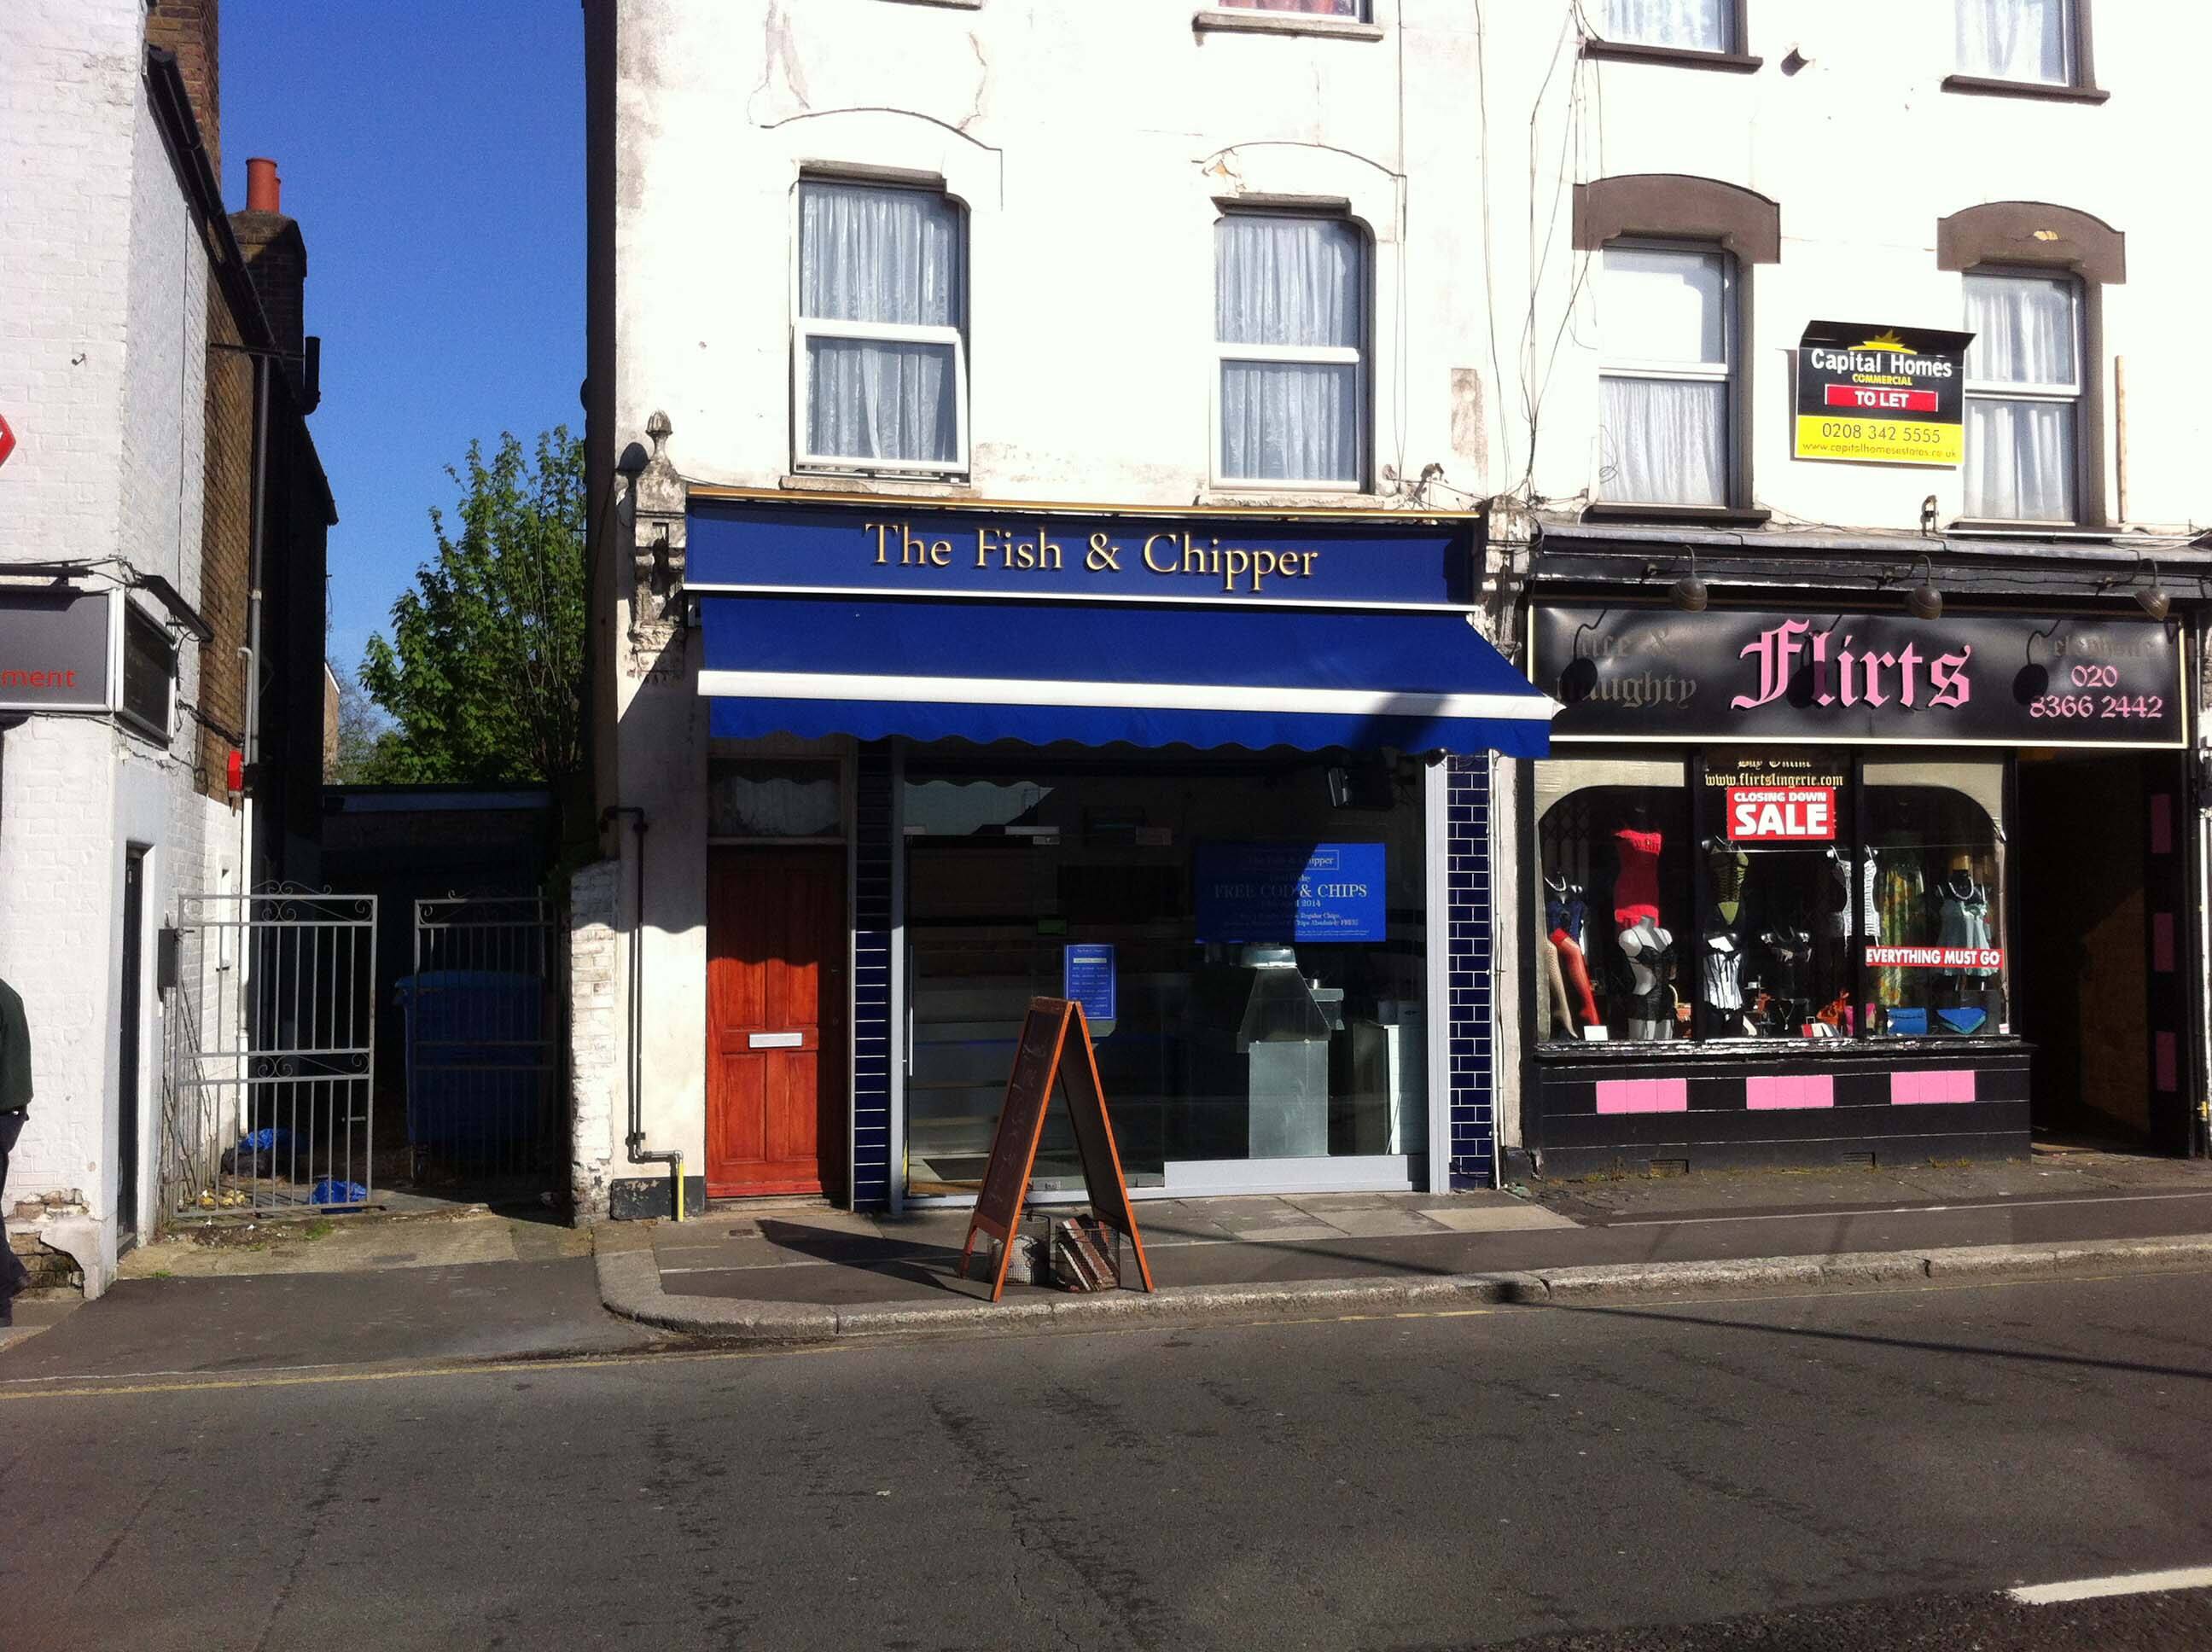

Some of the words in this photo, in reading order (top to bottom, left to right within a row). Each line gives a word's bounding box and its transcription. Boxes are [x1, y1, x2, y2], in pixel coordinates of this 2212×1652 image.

[1811, 349, 1881, 374] Capital
[1891, 353, 1953, 377] Homes
[1852, 373, 1912, 386] COMMERCIAL
[1854, 391, 1876, 405] TO
[1880, 393, 1909, 408] LET
[1822, 423, 1861, 439] 0208
[1867, 426, 1896, 440] 342
[1903, 428, 1941, 443] 5555
[865, 522, 952, 567] The
[975, 528, 1063, 570] Fish
[1086, 532, 1121, 573] &
[1144, 532, 1319, 591] Chipper
[1731, 618, 1971, 710] Flirts
[2071, 665, 2118, 689] 020
[2029, 695, 2093, 718] 8366
[2100, 695, 2163, 718] 2442
[1705, 773, 1843, 788] www.flirtslingerie.com
[1734, 791, 1785, 802] CLOSING
[1789, 792, 1827, 802] DOWN
[1734, 804, 1828, 836] SALE
[1300, 883, 1313, 898] &
[1318, 883, 1367, 898] CHIPS
[1866, 947, 1941, 964] EVERYTHING
[1944, 950, 1976, 965] MUST
[1980, 951, 2000, 965] GO
